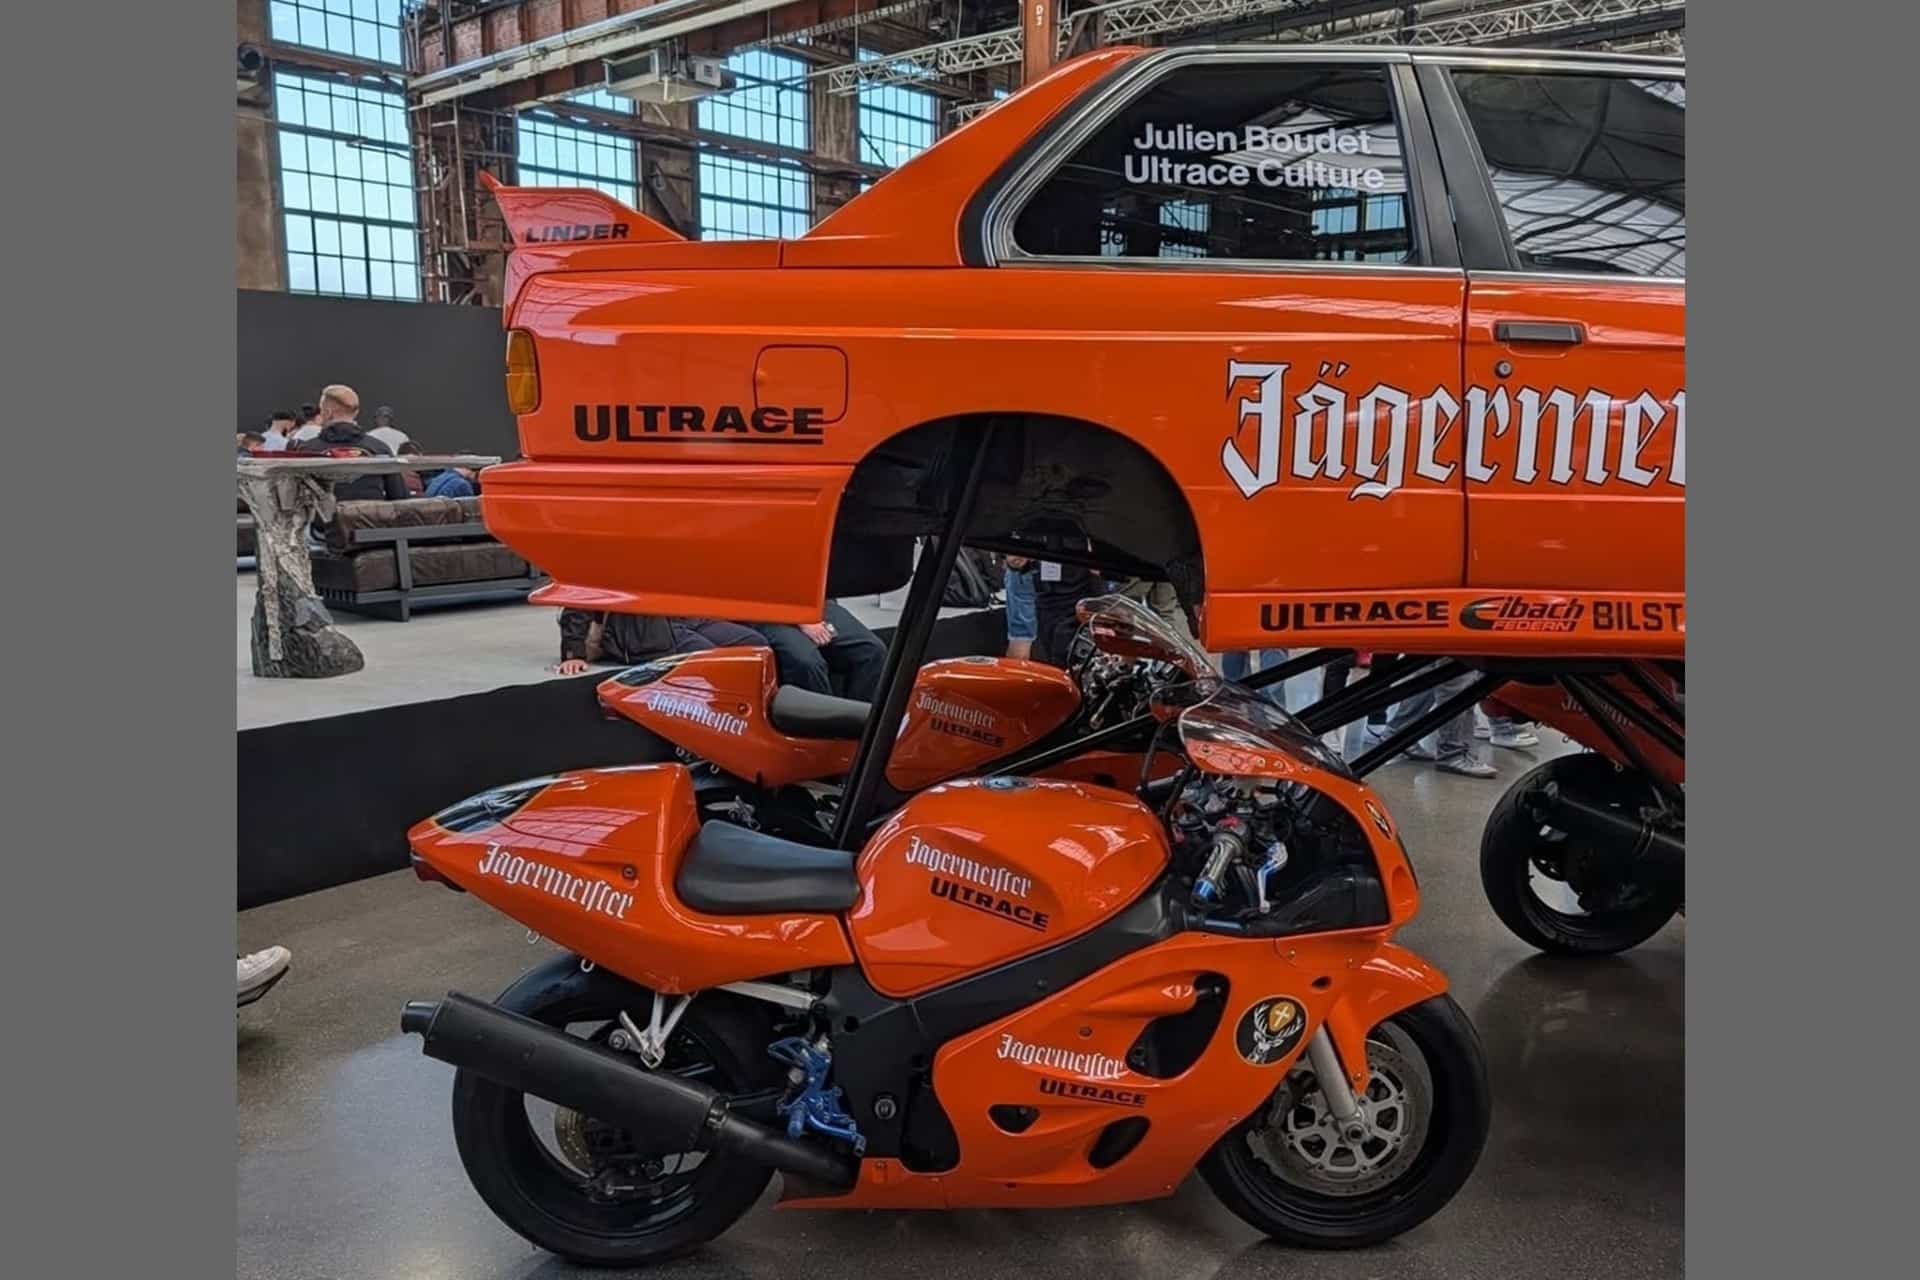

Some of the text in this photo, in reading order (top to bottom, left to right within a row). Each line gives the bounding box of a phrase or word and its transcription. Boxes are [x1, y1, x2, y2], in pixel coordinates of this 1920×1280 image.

[1134, 123, 1371, 153] Julien Boudet
[1124, 155, 1385, 187] Ultrace Culture
[526, 223, 629, 242] LINDER
[574, 404, 824, 445] ULTRACE
[1261, 600, 1449, 631] ULTRACE
[1459, 596, 1585, 631] Eibach
[1492, 620, 1577, 632] FEDERN
[930, 717, 1007, 748] ULTRACE
[930, 876, 1049, 932] ULTRACE
[1039, 1078, 1147, 1108] ULTRACE
